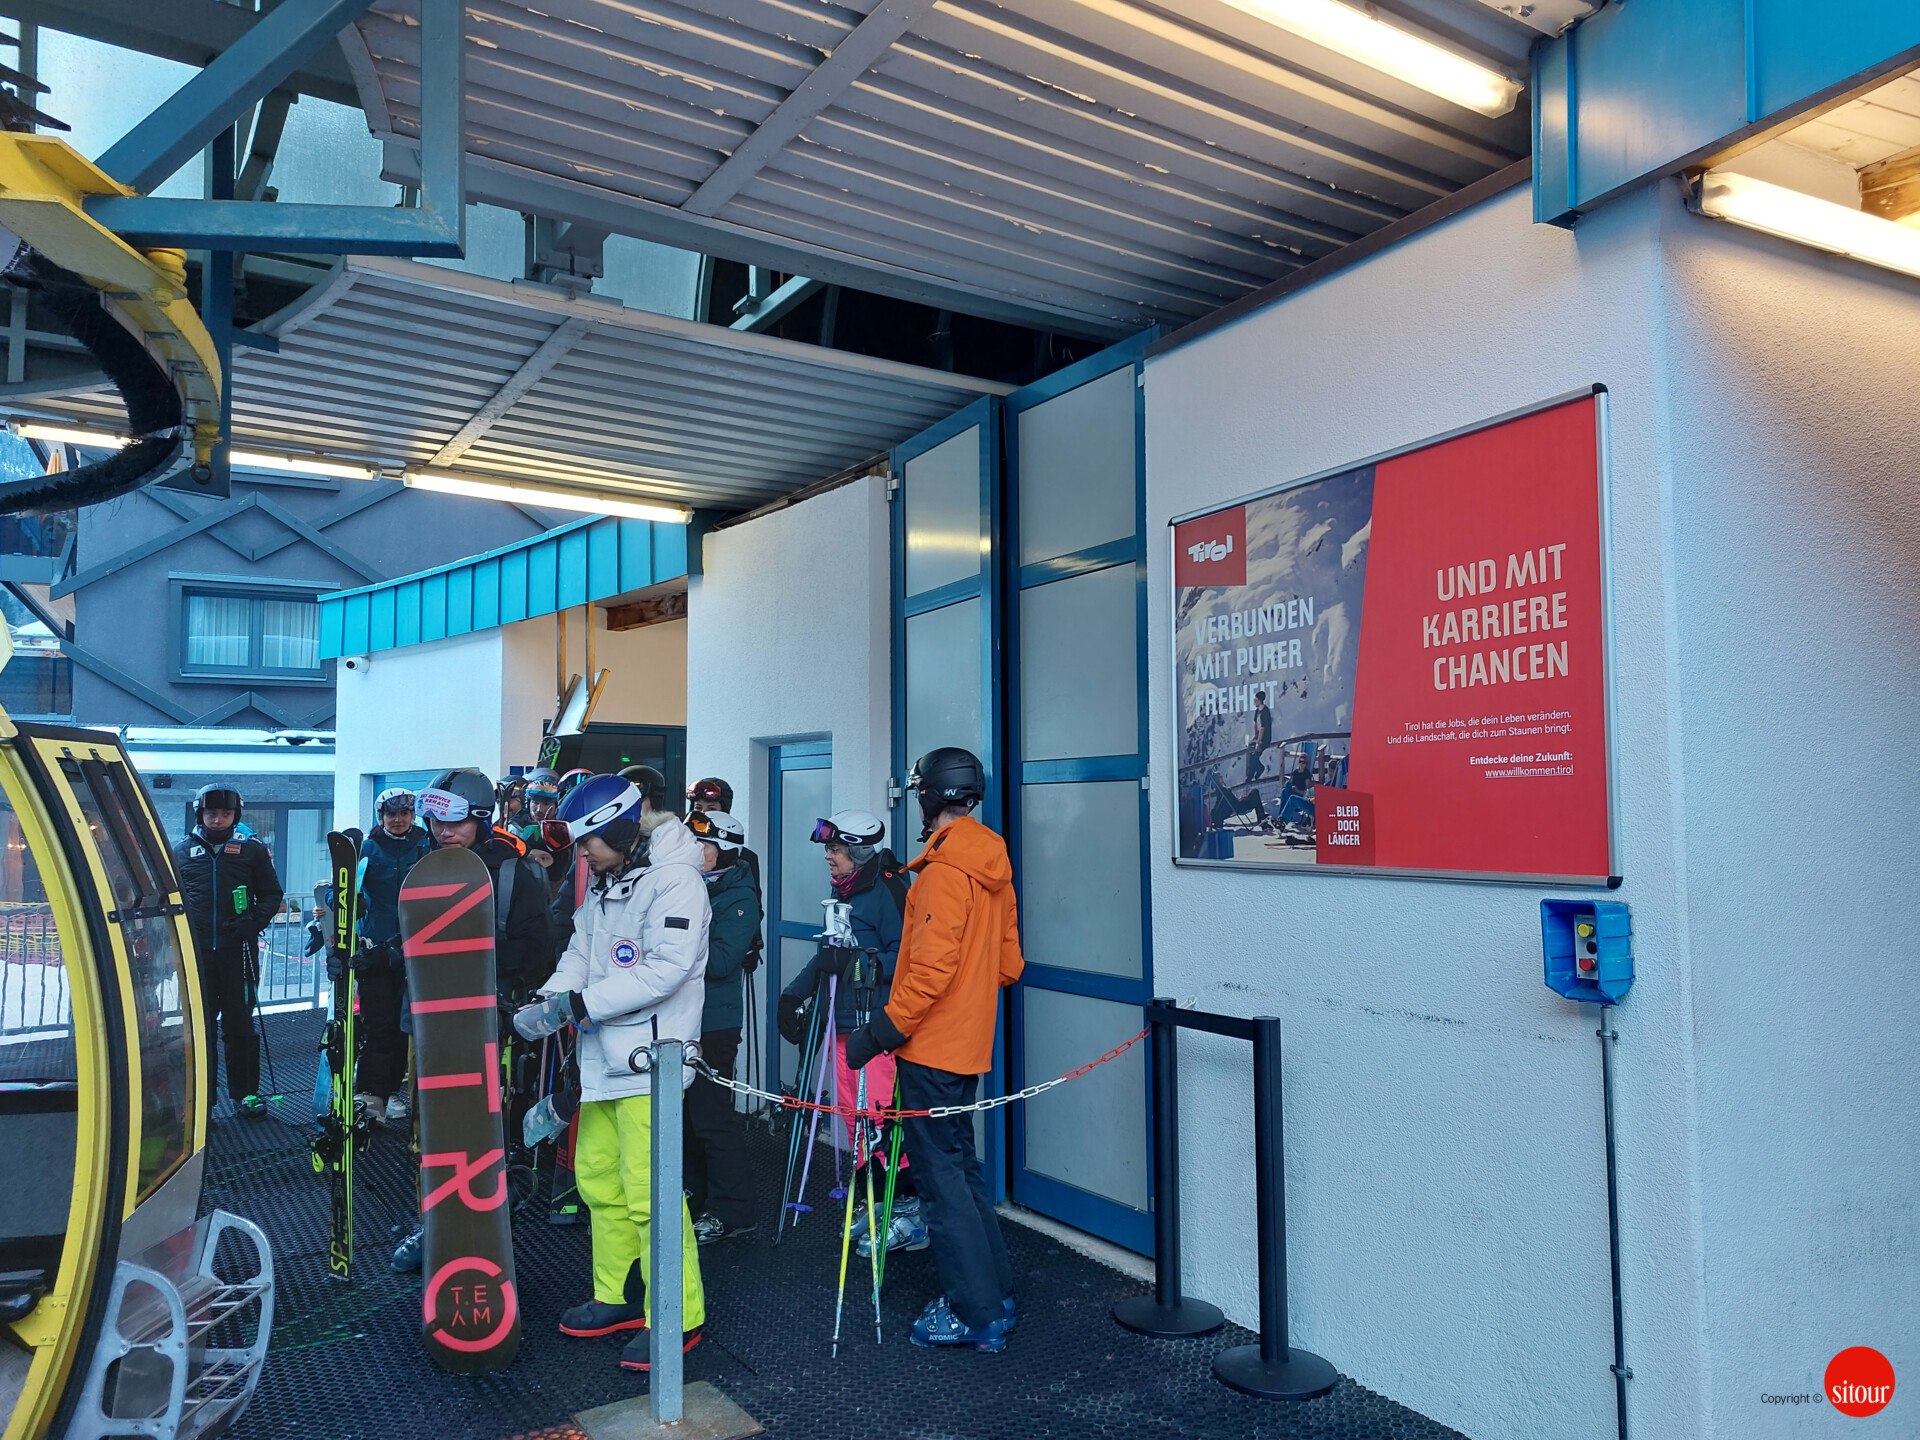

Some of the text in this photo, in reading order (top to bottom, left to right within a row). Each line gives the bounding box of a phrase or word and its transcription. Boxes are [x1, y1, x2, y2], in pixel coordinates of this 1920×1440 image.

[1188, 535, 1233, 562] Tirol
[1437, 543, 1566, 601] UND MIT
[1194, 597, 1314, 646] VERBUNDEN
[1423, 592, 1567, 648] KARRIERE
[1195, 639, 1303, 681] MIT PURER
[1434, 641, 1569, 690] CHANCEN
[1404, 710, 1571, 731] Tirol hat die Jobs, die dein Leben verändern.
[1387, 723, 1572, 744] Und die Landschaft, die dich zum Staunen bringt.
[1470, 751, 1573, 765] Entdecke deine Zukunft:
[1485, 764, 1574, 777] www.willkommen.tirol
[1337, 820, 1360, 831] DOCH
[1328, 831, 1360, 846] LÄNGER
[337, 867, 349, 950] HEAD
[929, 1333, 959, 1341] ATOMIC
